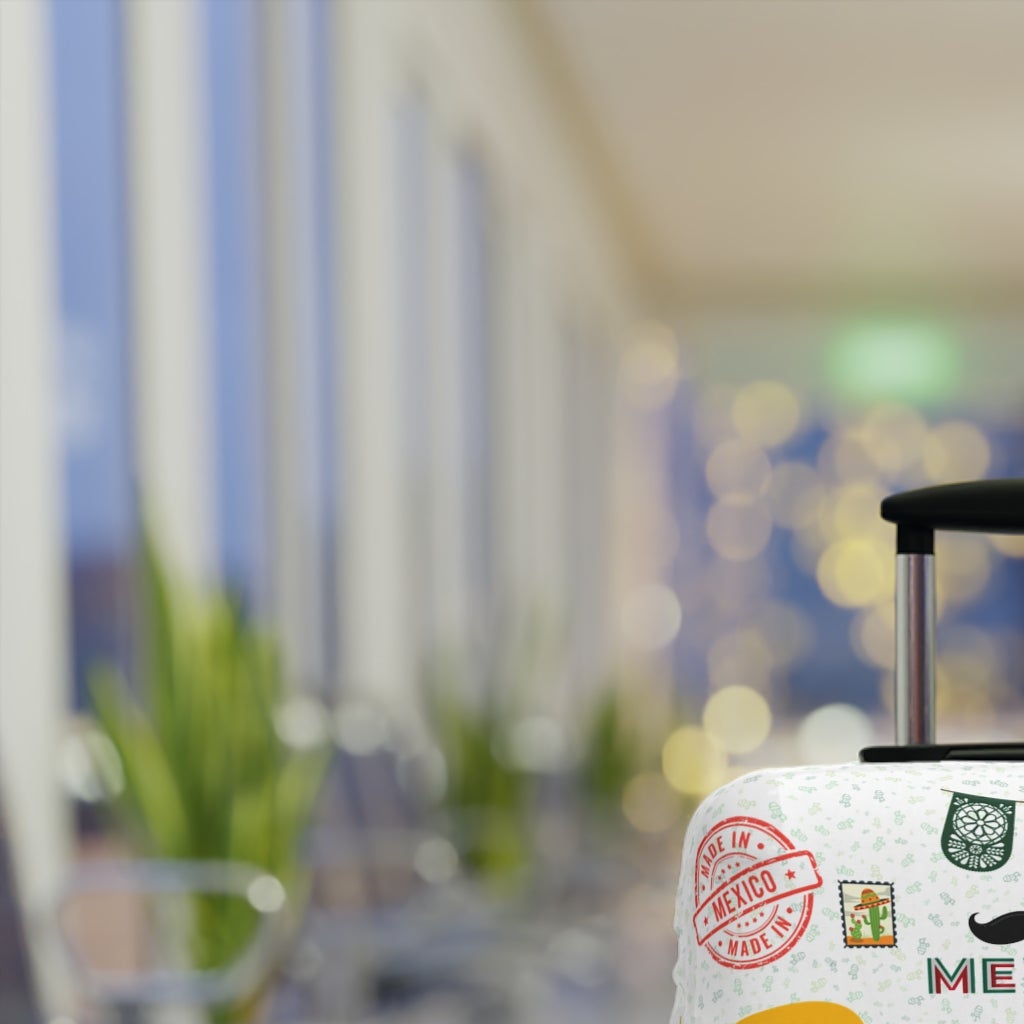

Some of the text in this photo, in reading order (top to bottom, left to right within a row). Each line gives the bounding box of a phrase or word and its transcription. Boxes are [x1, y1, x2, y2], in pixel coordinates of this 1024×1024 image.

[701, 831, 751, 878] MADE IN
[711, 870, 777, 921] MEXICO
[727, 915, 792, 957] MADE IN
